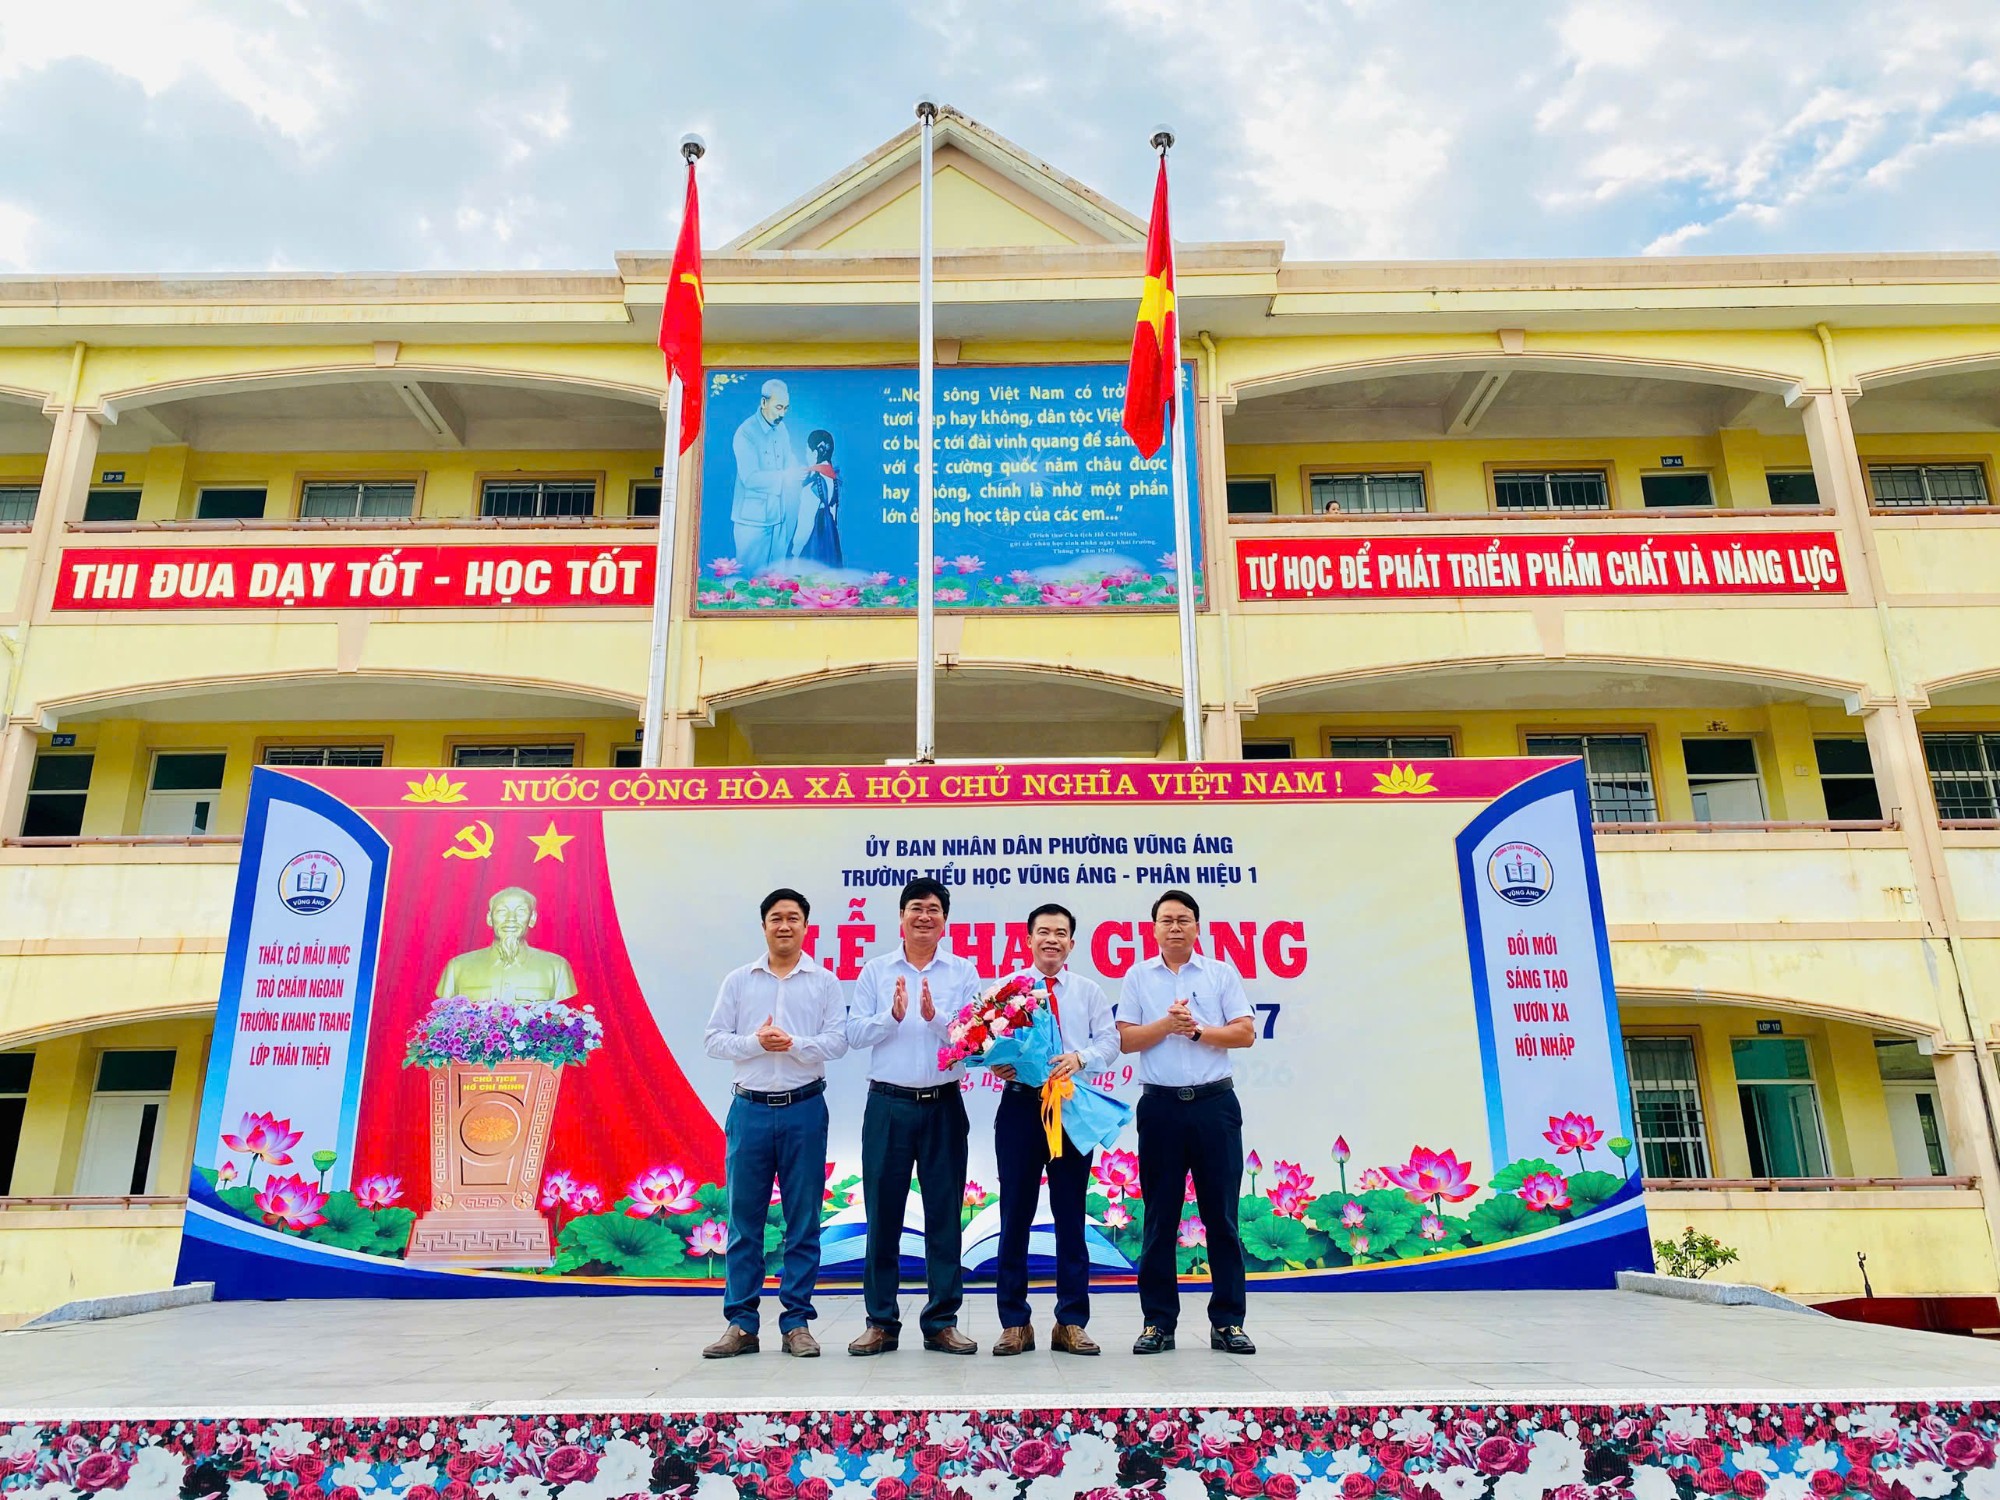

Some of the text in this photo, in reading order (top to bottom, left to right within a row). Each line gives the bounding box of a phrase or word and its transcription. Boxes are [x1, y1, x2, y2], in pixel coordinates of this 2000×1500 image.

[944, 387, 980, 405] sông
[989, 386, 1019, 404] Việt
[1030, 386, 1064, 400] Nam
[1075, 384, 1092, 399] có
[1102, 382, 1126, 398] trở
[883, 412, 912, 426] tươi
[950, 410, 976, 429] hay
[982, 410, 1033, 428] không,
[1037, 408, 1065, 423] dân
[1070, 408, 1093, 427] tộc
[883, 436, 900, 450] có
[944, 433, 964, 449] tới
[968, 434, 991, 449] đài
[995, 434, 1027, 449] vinh
[1031, 436, 1079, 451] quang
[1083, 430, 1102, 447] để
[883, 456, 1167, 477] với cc cường quốc năm châu được
[883, 484, 910, 503] hay
[980, 482, 1021, 498] chính
[1030, 482, 1043, 498] là
[1053, 482, 1082, 497] nhờ
[1091, 481, 1121, 500] một
[1130, 478, 1168, 499] phần
[883, 508, 906, 523] lớn
[934, 508, 960, 527] ông
[965, 507, 992, 526] học
[995, 507, 1020, 525] tập
[1024, 505, 1050, 522] của
[1054, 506, 1078, 521] các
[72, 547, 642, 606] THI ĐUA DẠY TỐT - HỌC TỐT
[1245, 538, 1838, 598] TỰ HỌC ĐỂ PHÁT TRIỂN PHẨM CHẤT VÀ NĂNG LỰC
[502, 766, 1343, 806] NƯỚC CỘNG HÒA XÃ HỘI CHỦ NGHĨA VIỆT NAM !
[866, 834, 1233, 857] ỦY BAN NHÂN DÂN PHƯỜNG VŨNG ÁNG
[842, 865, 918, 887] TRƯỜNG
[925, 862, 966, 886] TIỂU
[973, 868, 1011, 888] HỌC
[1018, 864, 1070, 884] VŨNG
[1076, 864, 1116, 884] ÁNG
[1136, 863, 1190, 884] PHÂN
[1197, 863, 1242, 887] HIỆU
[1248, 867, 1257, 884] 1
[287, 942, 301, 964] CÔ
[302, 938, 326, 965] MẪU
[328, 944, 351, 969] MỰC
[1090, 920, 1308, 979] GING
[1508, 929, 1558, 956] ĐỔI MỚI
[256, 974, 344, 998] TRÒ CHĂM NGOAN
[1506, 966, 1568, 993] SÁNG TẠO
[240, 1008, 350, 1032] TRƯỜNG KHANG TRANG
[1514, 1002, 1569, 1022] VƯƠN XA
[250, 1042, 331, 1070] LỚP THÂN THIỆN
[1515, 1034, 1575, 1061] HỘI NHẬP
[1122, 1065, 1133, 1085] 9
